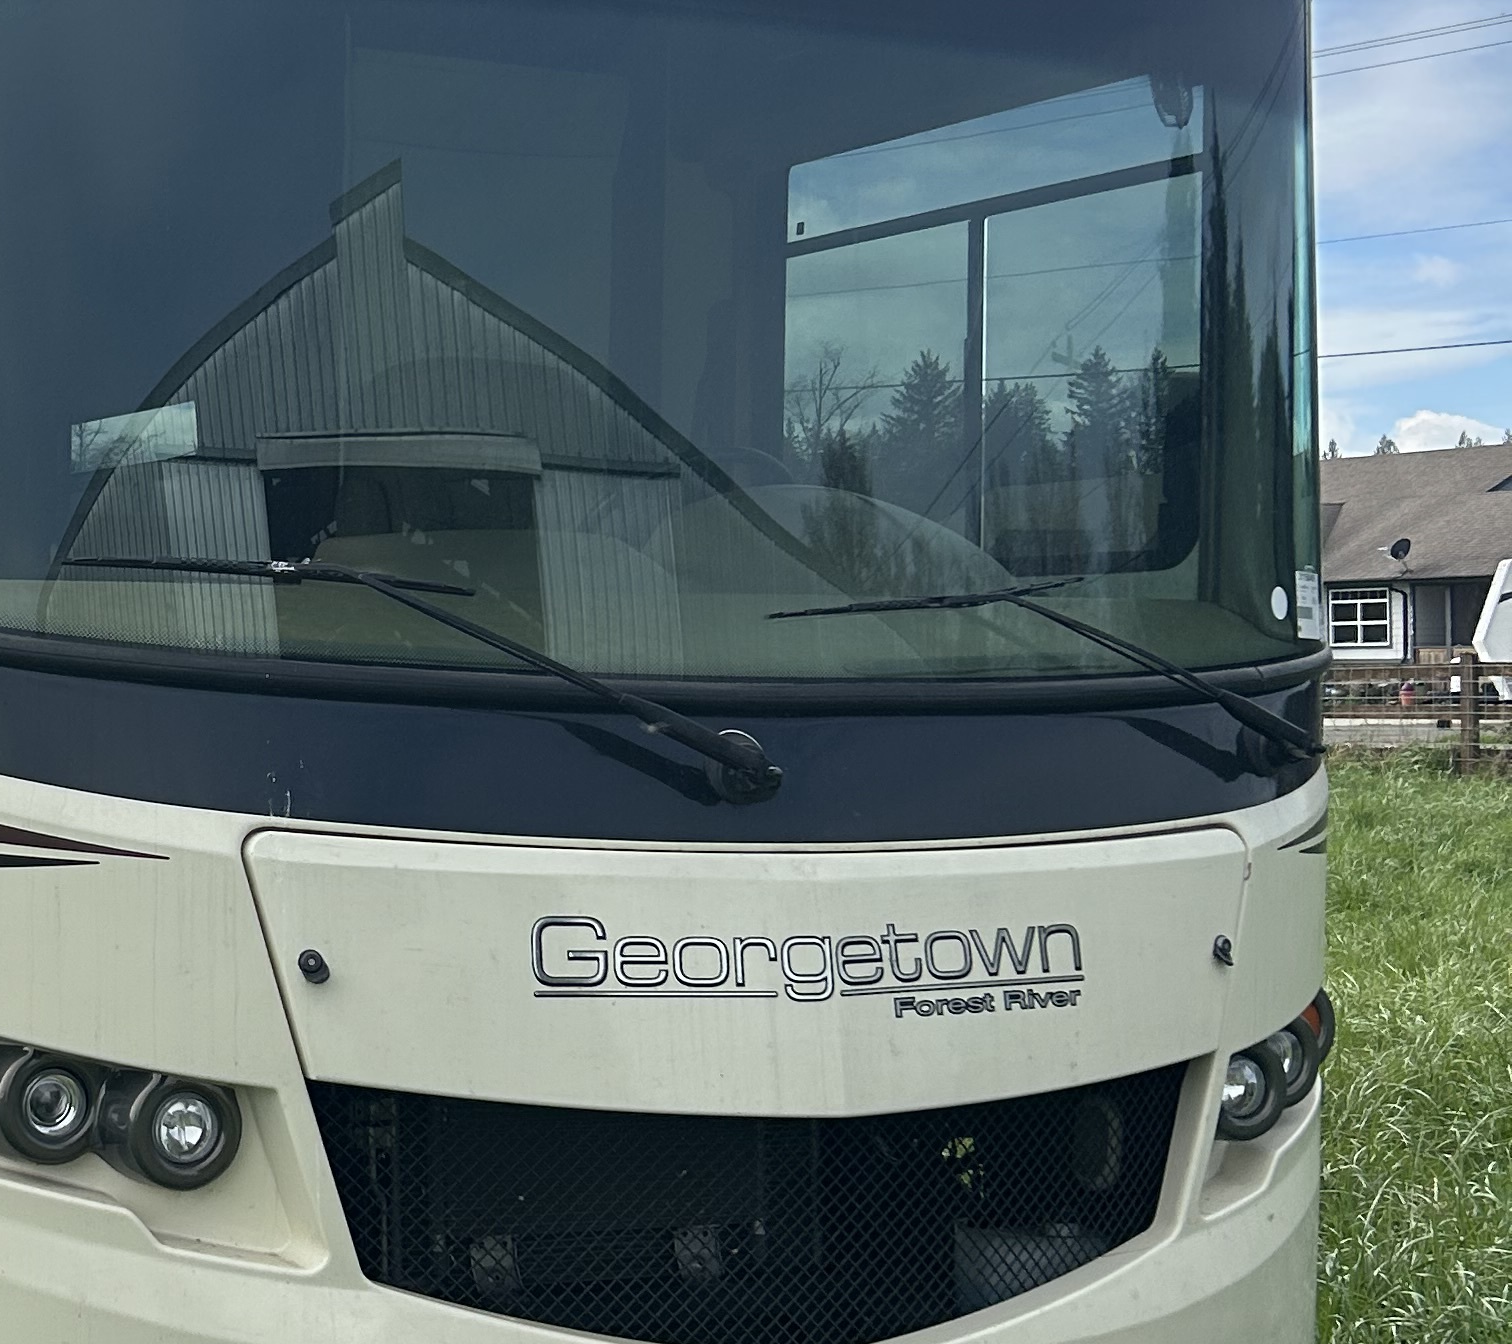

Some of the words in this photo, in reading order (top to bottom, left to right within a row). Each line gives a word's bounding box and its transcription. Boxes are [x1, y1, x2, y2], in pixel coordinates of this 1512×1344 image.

[531, 915, 1082, 1002] Georgetown
[893, 992, 995, 1018] Forest
[1003, 989, 1081, 1011] River
